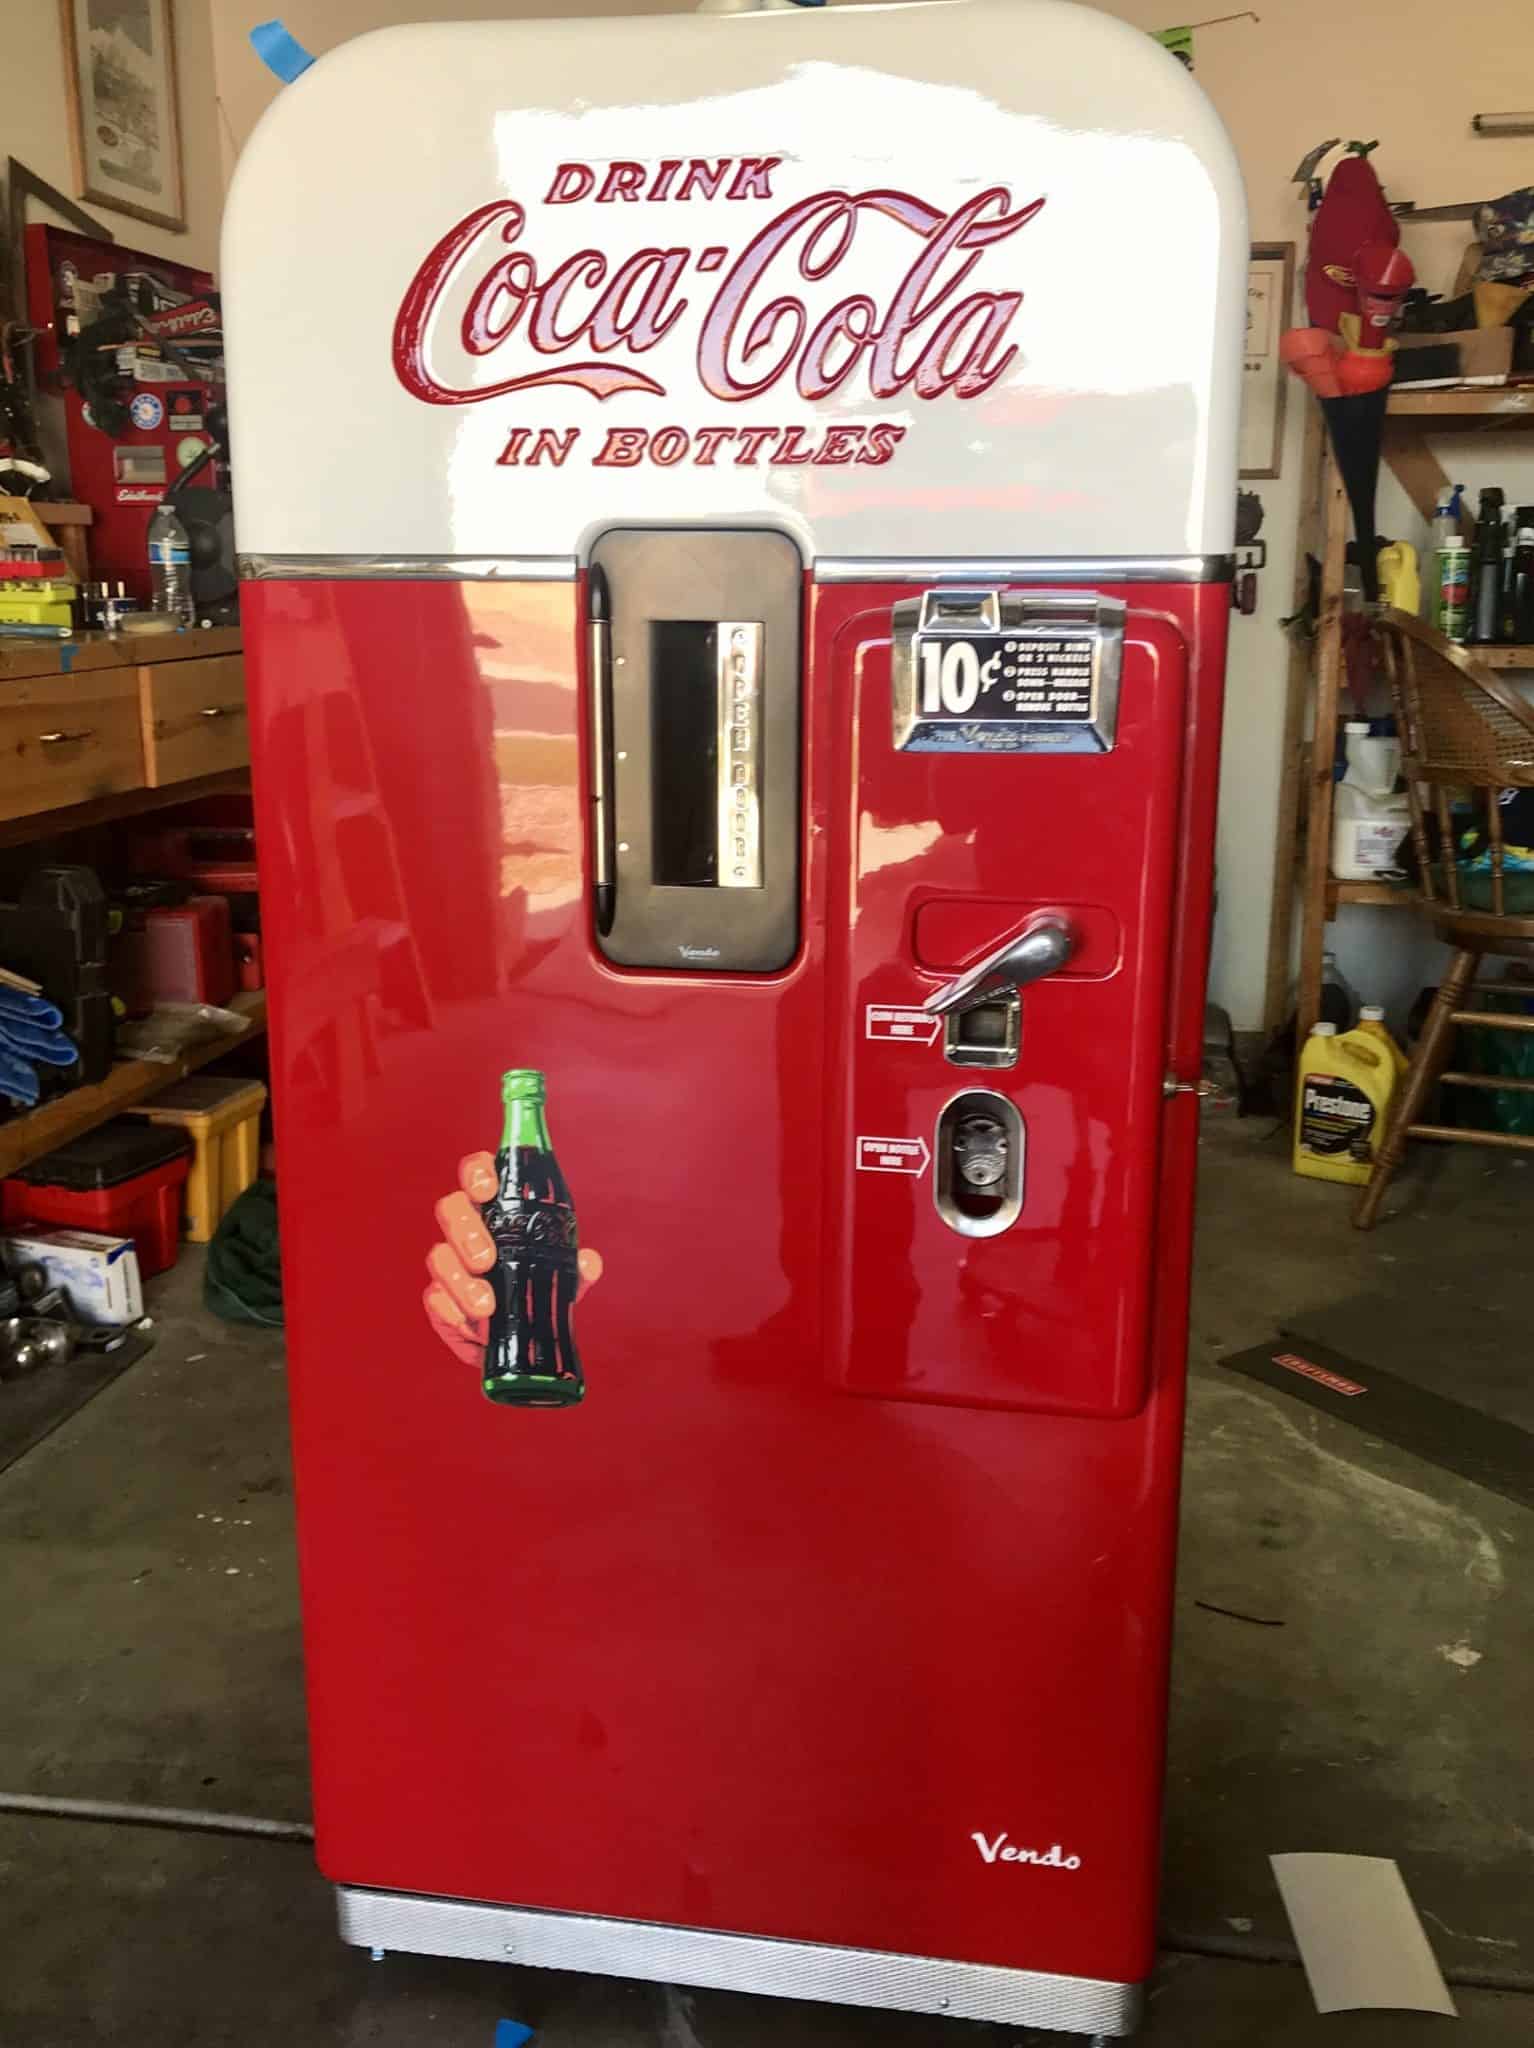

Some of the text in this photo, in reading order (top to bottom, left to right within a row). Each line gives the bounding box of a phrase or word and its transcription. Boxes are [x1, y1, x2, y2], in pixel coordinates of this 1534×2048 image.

[544, 157, 782, 204] DRINK
[391, 186, 1047, 406] Coca-Cola
[496, 424, 906, 467] IN BOTTLES
[1017, 653, 1033, 663] OR
[1036, 653, 1044, 663] 2
[1017, 667, 1048, 677] PRESS
[1016, 691, 1046, 701] OPEN
[1304, 1088, 1371, 1120] Prestone
[970, 1831, 1082, 1870] Vendo
